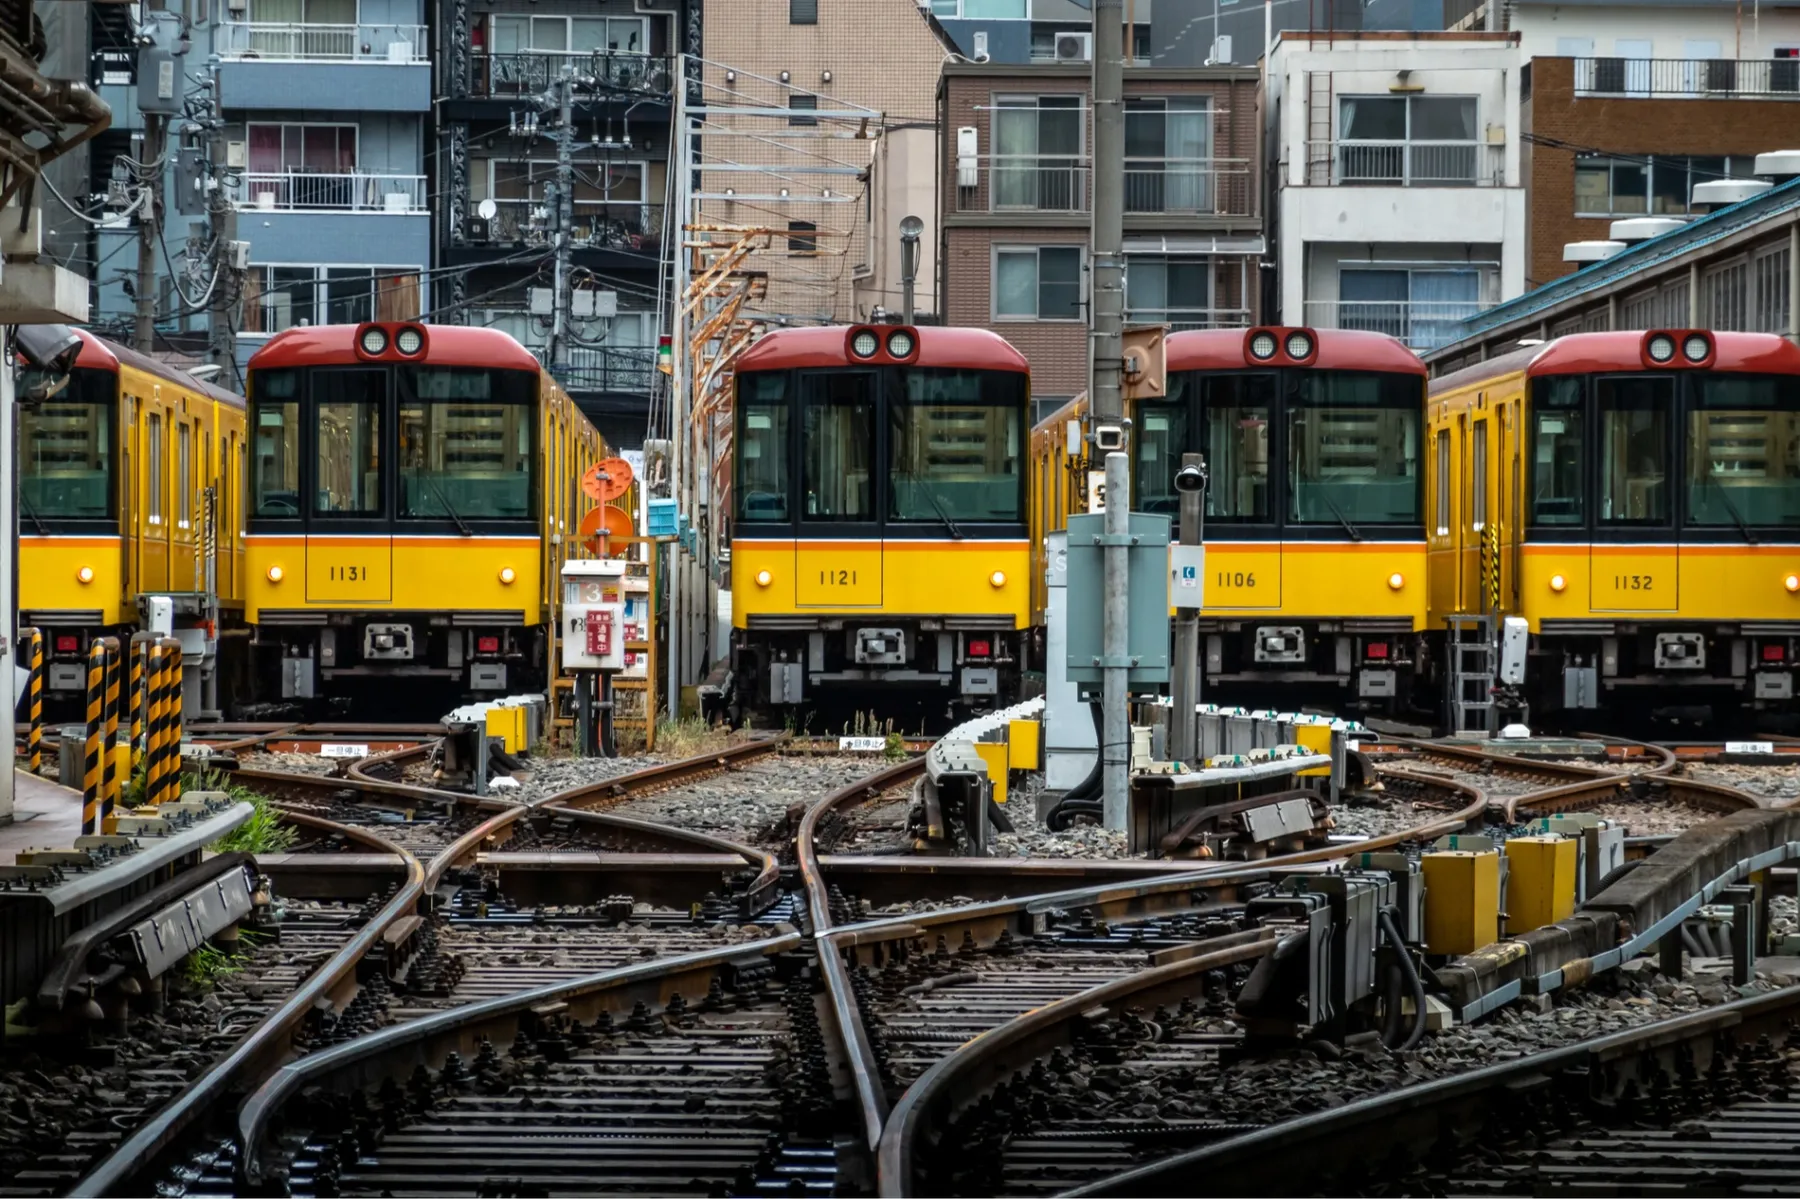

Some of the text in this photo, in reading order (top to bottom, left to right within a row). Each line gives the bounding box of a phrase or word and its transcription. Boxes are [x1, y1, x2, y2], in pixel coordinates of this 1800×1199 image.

[330, 566, 366, 581] 1131
[820, 570, 856, 585] 1121
[1218, 572, 1255, 587] 1106
[1615, 575, 1653, 590] 1132
[586, 583, 600, 602] 3
[293, 743, 300, 753] 2
